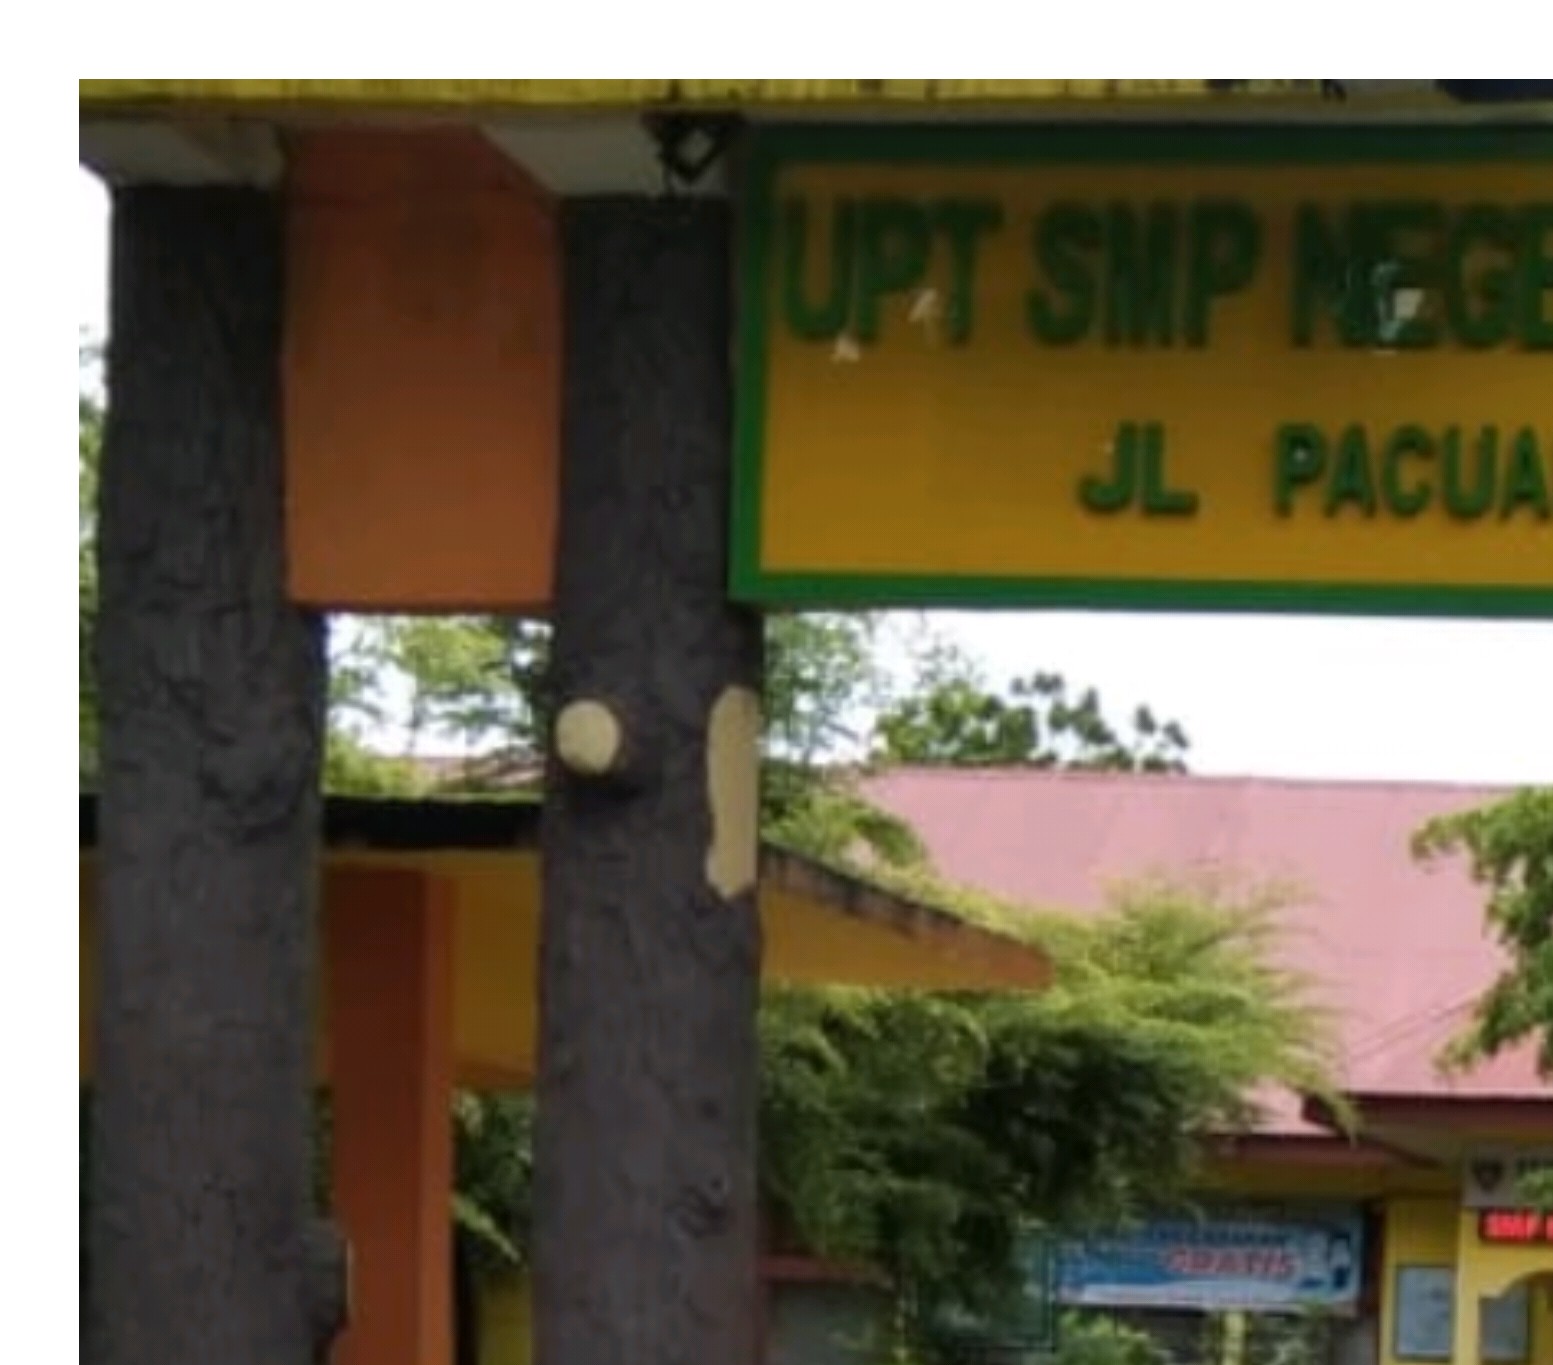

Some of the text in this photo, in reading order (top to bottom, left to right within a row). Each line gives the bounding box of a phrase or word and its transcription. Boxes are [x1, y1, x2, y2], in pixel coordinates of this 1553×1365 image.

[784, 196, 1005, 348] UPT
[1025, 198, 1261, 352] SMP
[1078, 421, 1198, 517] JL
